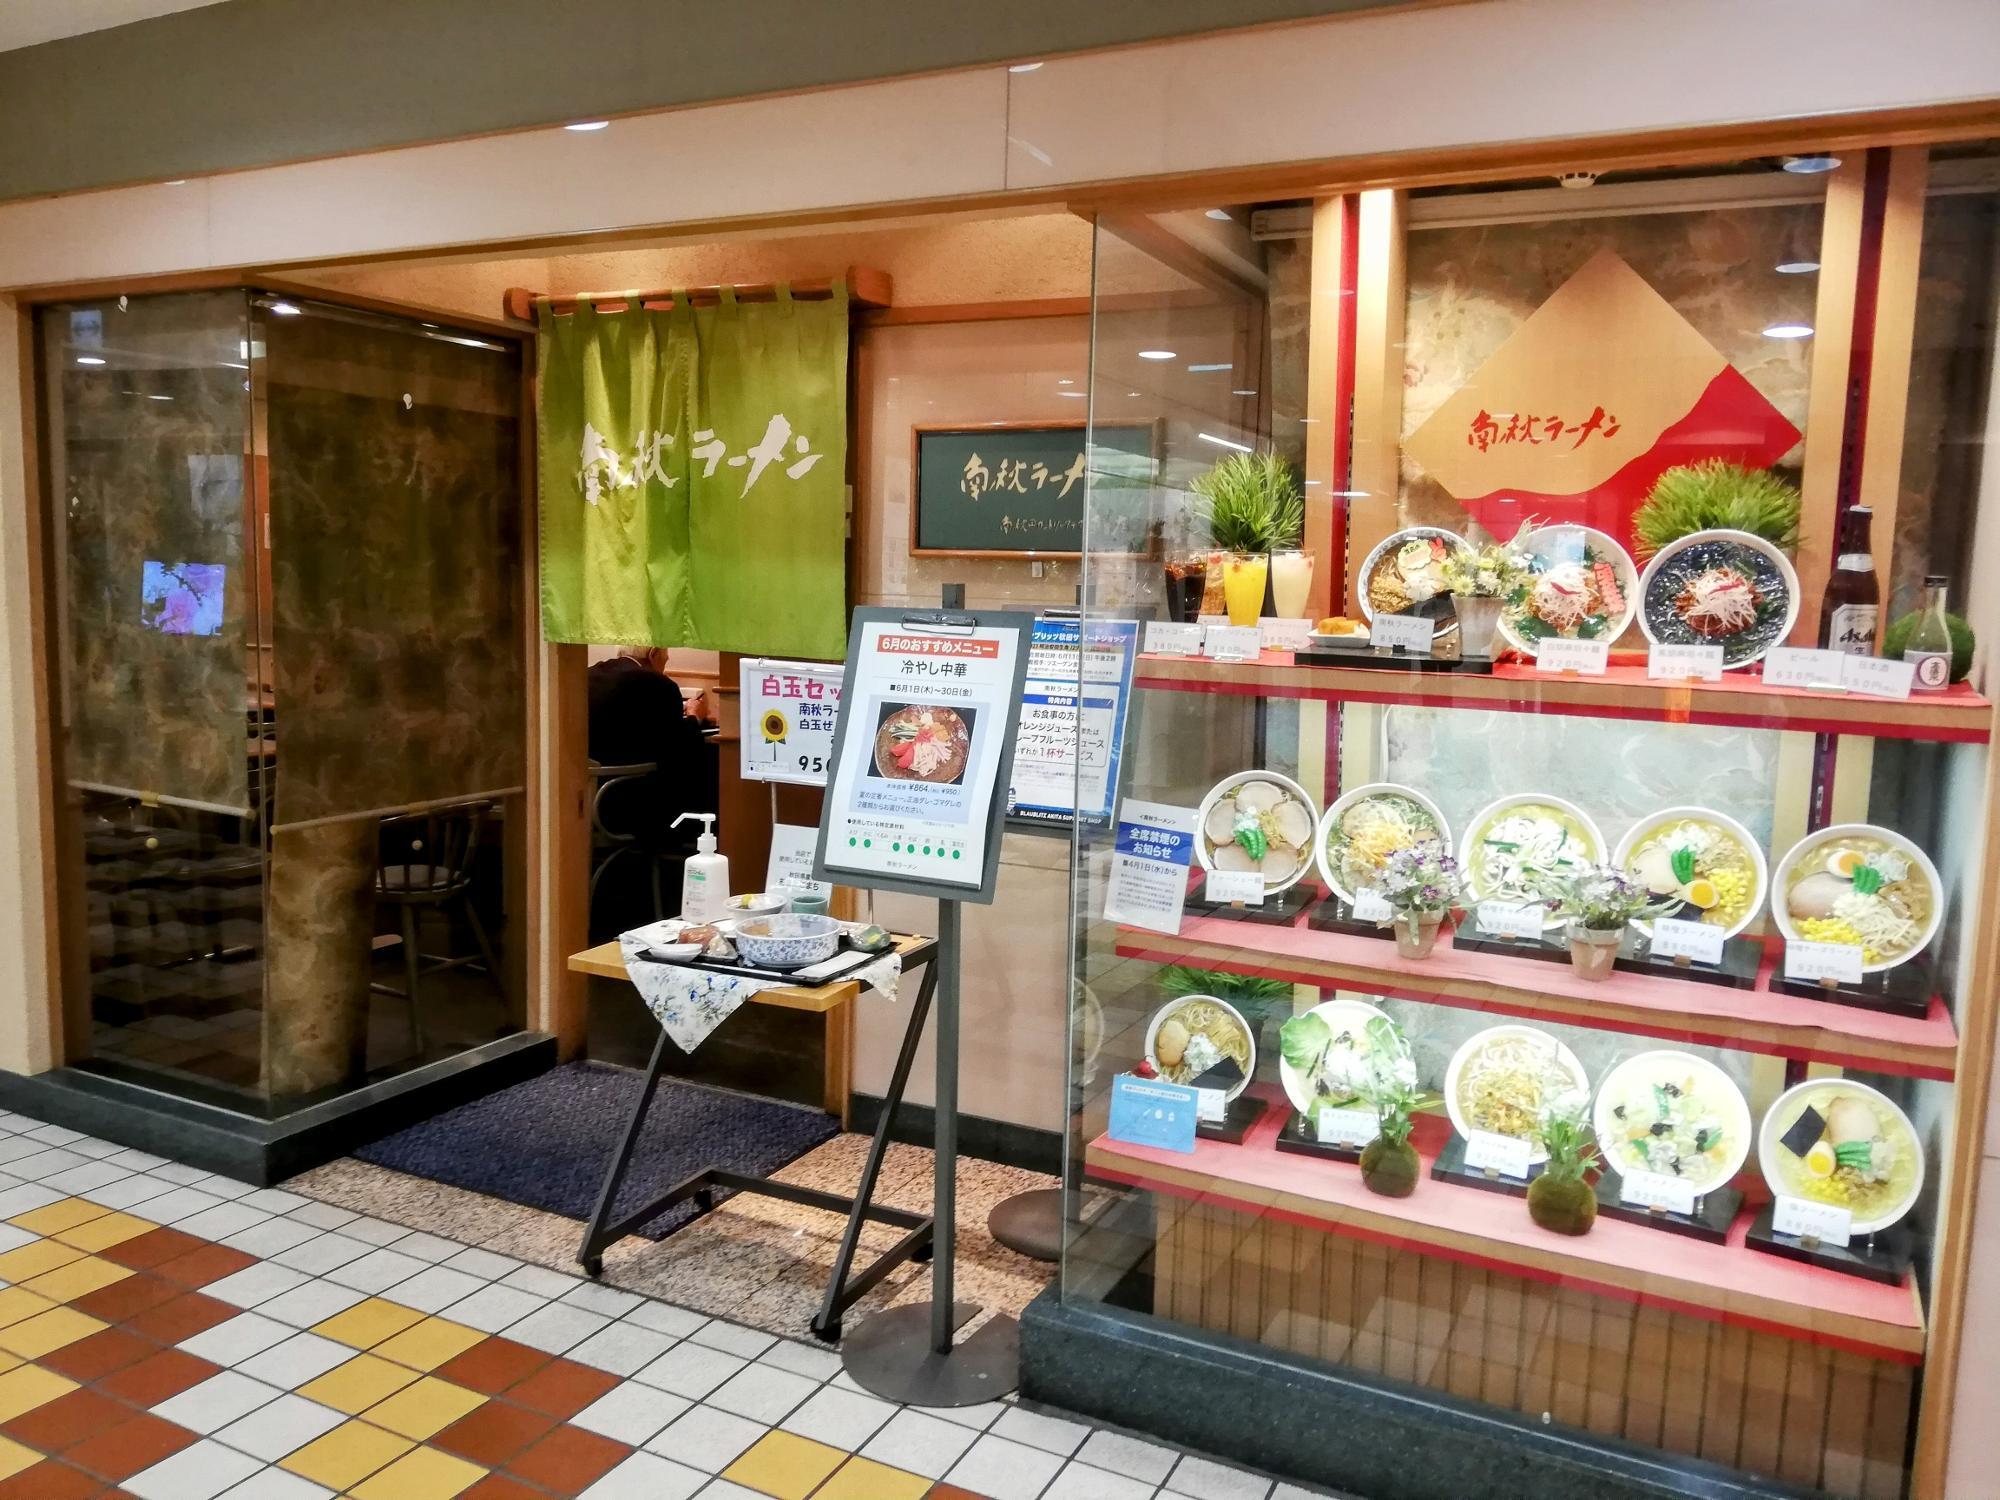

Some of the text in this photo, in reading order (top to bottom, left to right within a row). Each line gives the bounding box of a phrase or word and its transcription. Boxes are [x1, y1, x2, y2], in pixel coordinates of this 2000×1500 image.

[1467, 406, 1622, 453] 南秋ラーメン
[579, 413, 824, 507] 南秋ラーメン
[881, 637, 994, 655] 6月のおすすめメニュー
[900, 659, 968, 678] 冷やし中華
[1128, 828, 1181, 847] 全席禁煙の
[1132, 842, 1173, 859] お知らせ
